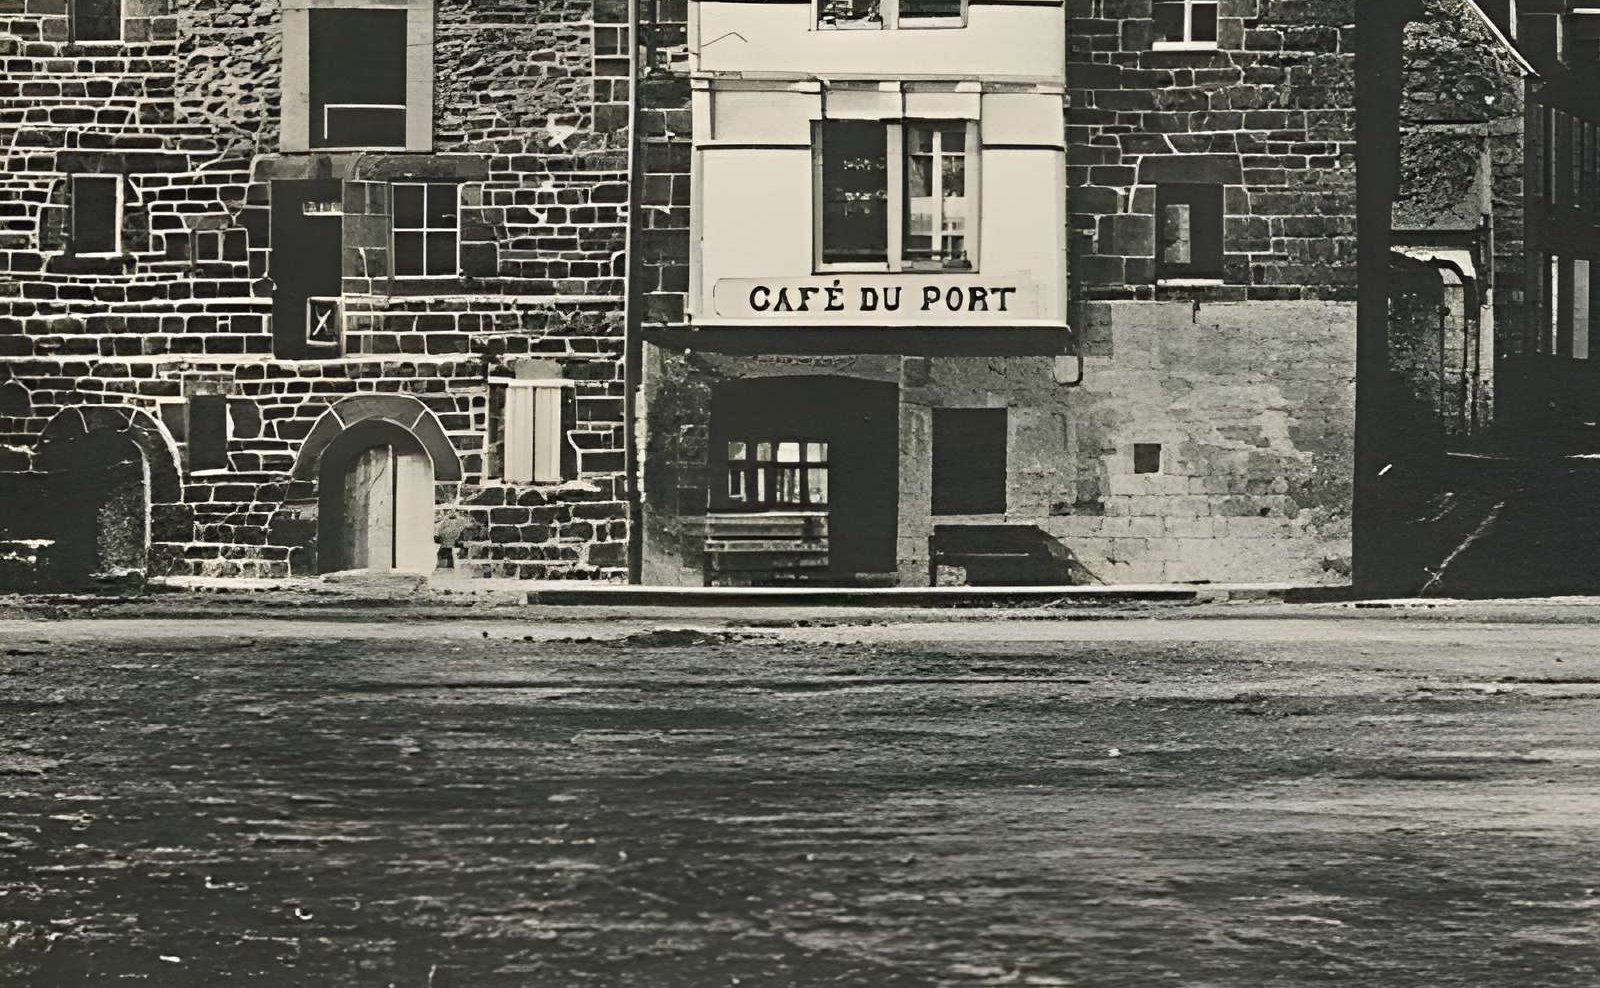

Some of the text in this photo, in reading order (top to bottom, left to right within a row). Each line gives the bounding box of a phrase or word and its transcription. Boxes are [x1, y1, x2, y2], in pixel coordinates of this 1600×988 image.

[749, 279, 1017, 312] CAFÉ DU PORT
